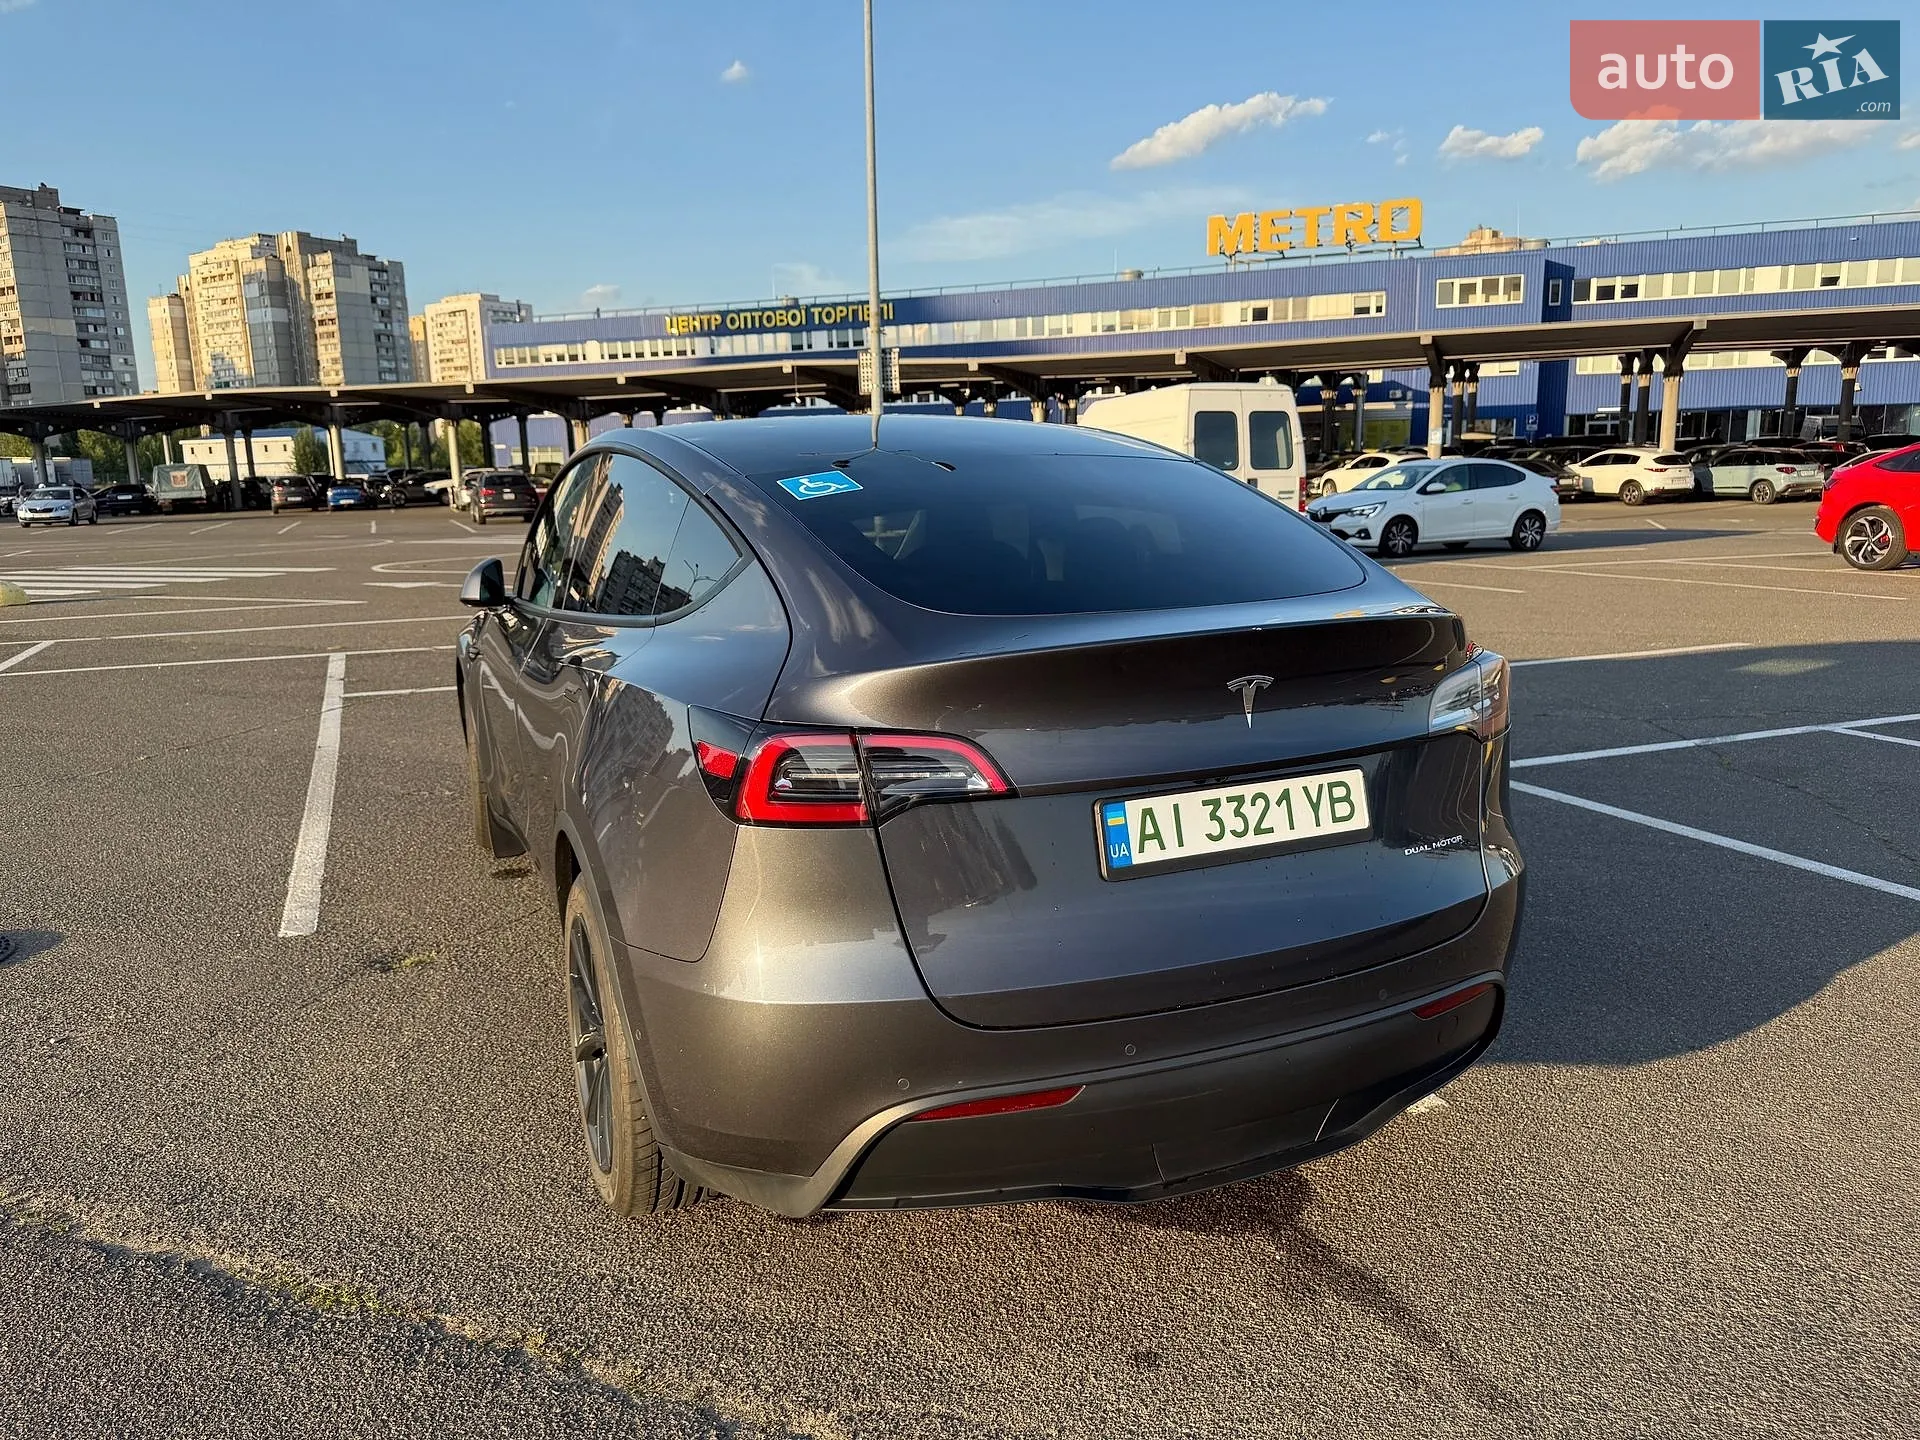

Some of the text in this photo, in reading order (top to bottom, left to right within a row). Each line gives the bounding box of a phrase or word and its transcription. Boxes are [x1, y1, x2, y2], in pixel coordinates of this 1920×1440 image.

[1207, 198, 1422, 256] METRO
[665, 314, 722, 336] ЦЕНТР
[725, 306, 808, 330] ОПТОВОЇ
[1201, 788, 1295, 842] 3321
[1302, 780, 1356, 828] YB
[1110, 843, 1130, 859] UA
[1404, 834, 1465, 856] DUAL MOTOR
